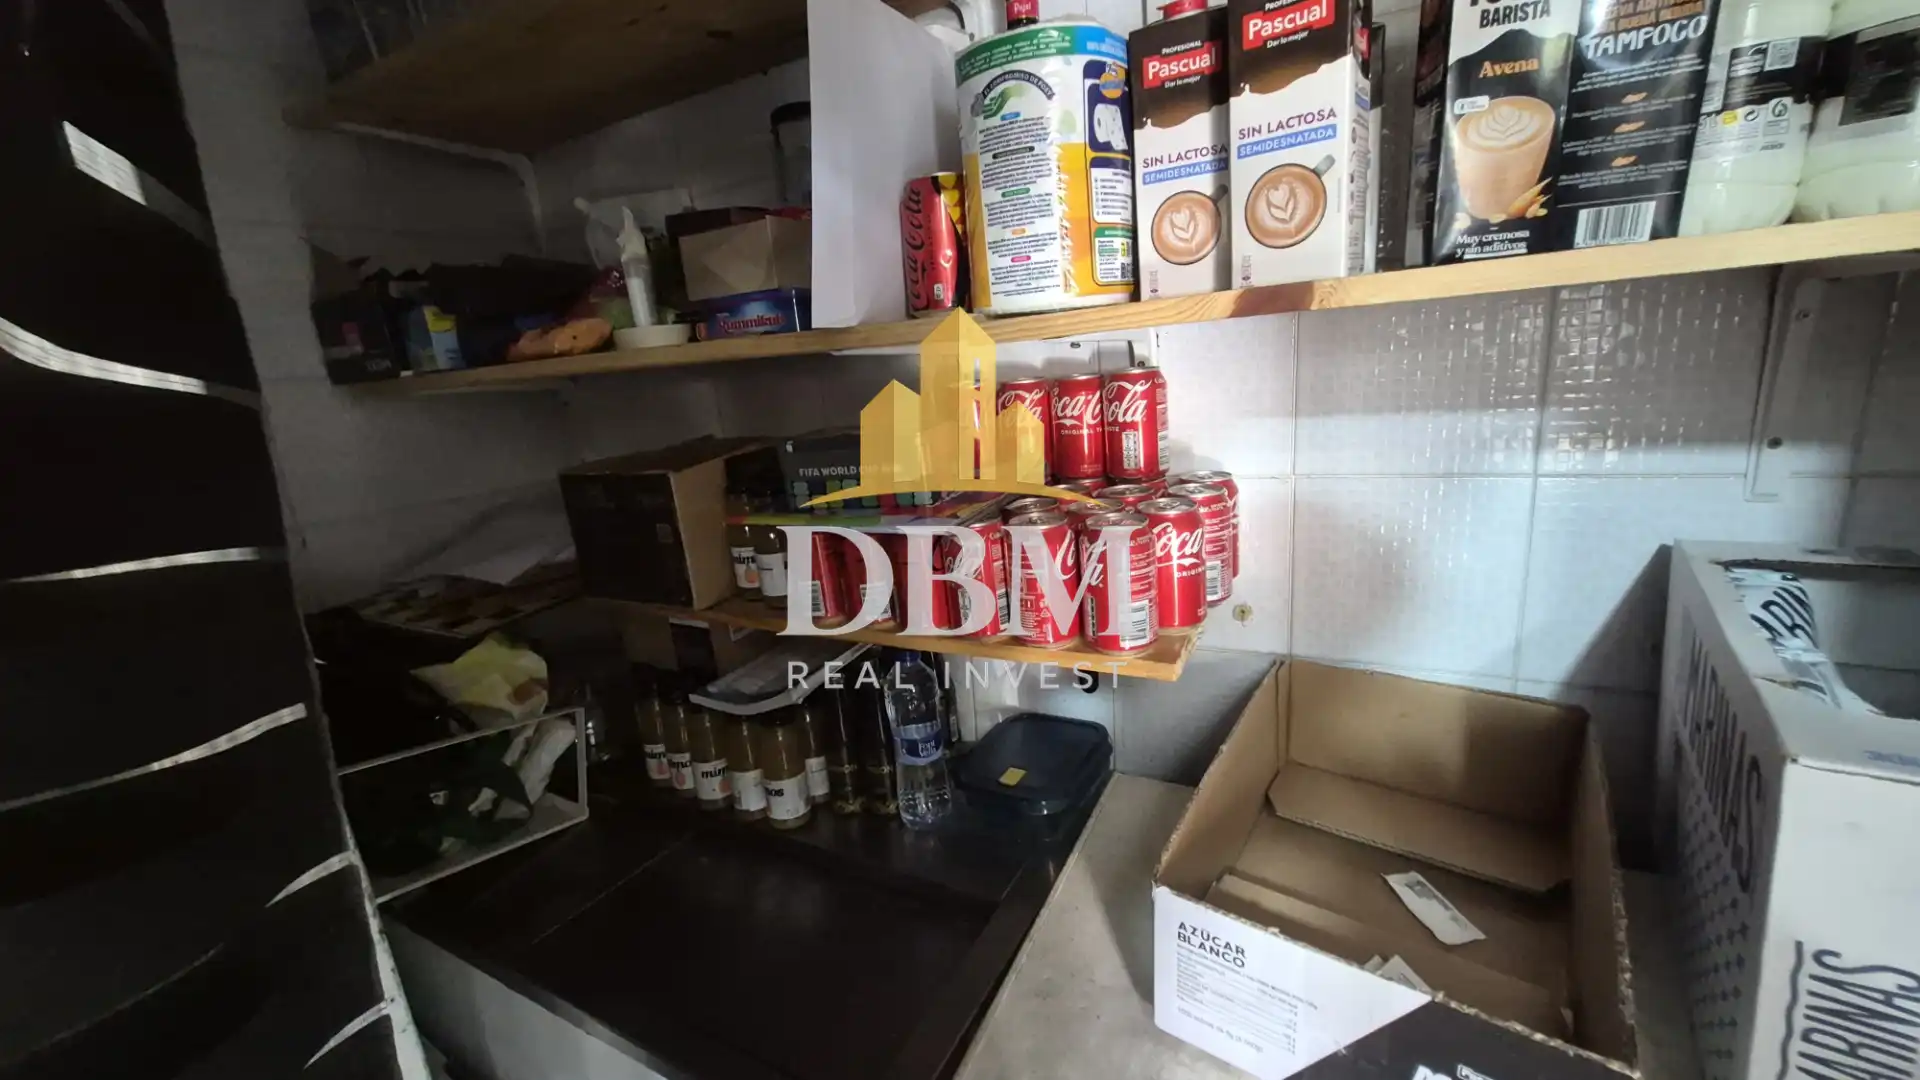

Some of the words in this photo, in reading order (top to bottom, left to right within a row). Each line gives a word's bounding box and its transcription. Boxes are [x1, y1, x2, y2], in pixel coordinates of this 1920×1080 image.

[1248, 0, 1327, 40] Pascual
[1479, 0, 1551, 29] BARISTA
[1161, 40, 1202, 55] PROFESIONAL
[1584, 15, 1708, 59] TAMPOCO
[1148, 47, 1216, 80] Pascual
[1478, 57, 1539, 79] Avena
[1238, 124, 1262, 140] SIN
[1267, 107, 1337, 134] LACTOSA
[1239, 128, 1334, 156] SEMIDESNATADA
[1142, 157, 1164, 169] SIN
[1168, 143, 1229, 164] LACTOSA
[1143, 161, 1226, 183] SEMIDESNATADA
[1456, 233, 1481, 248] Muy
[1482, 229, 1531, 242] cremosa
[1482, 240, 1528, 253] aditivos
[821, 465, 858, 477] WORLD
[1177, 931, 1245, 968] BLANCO
